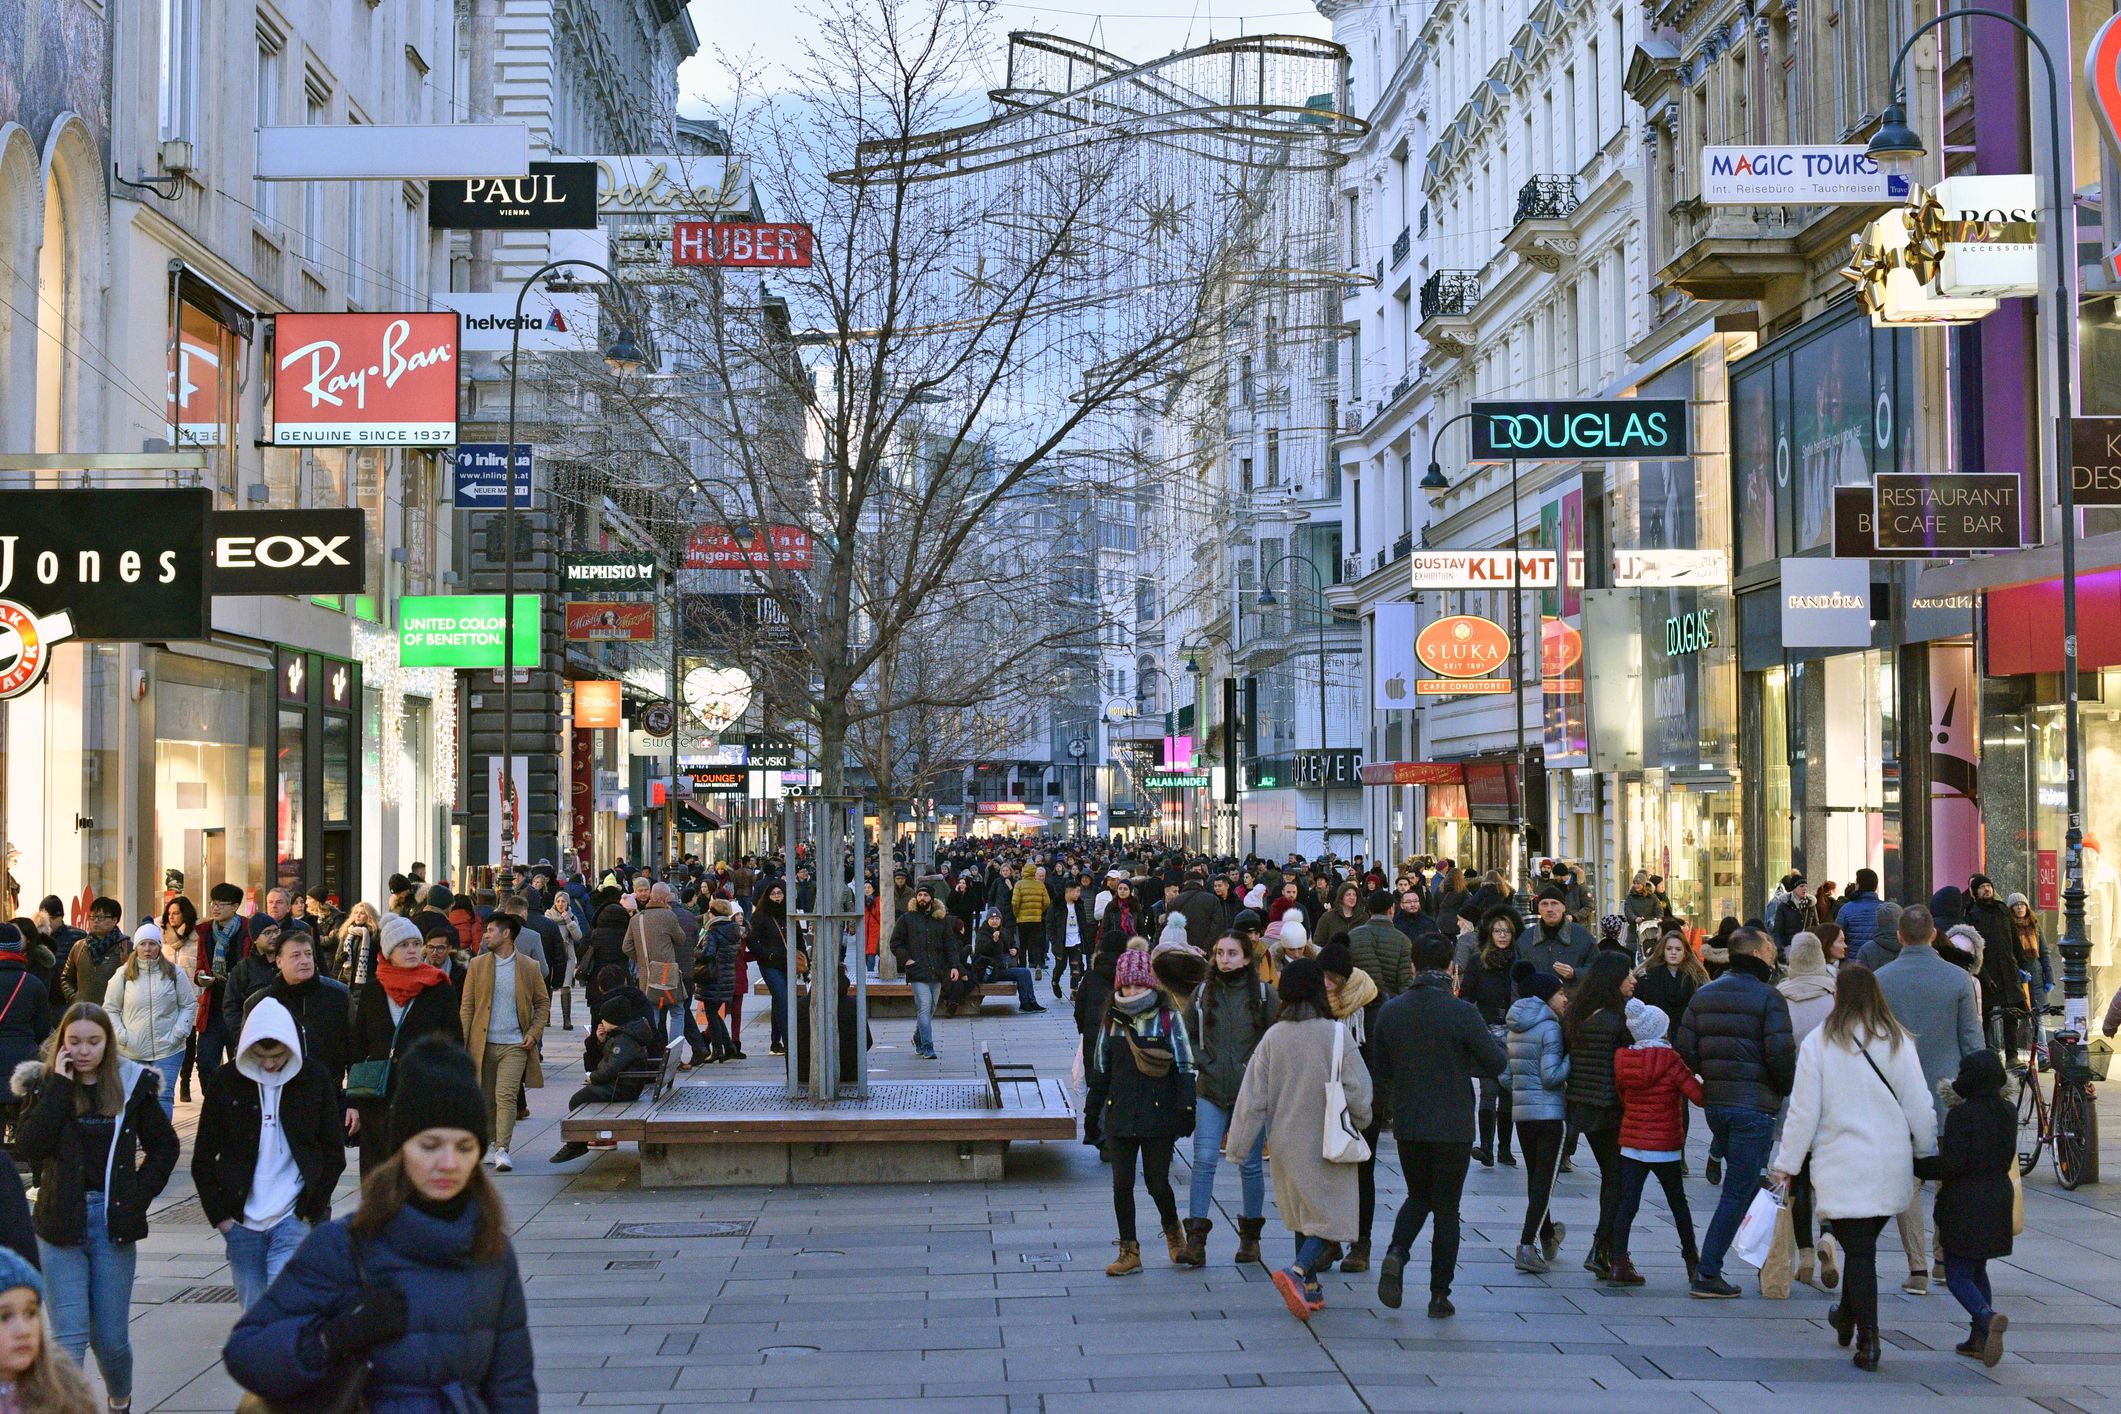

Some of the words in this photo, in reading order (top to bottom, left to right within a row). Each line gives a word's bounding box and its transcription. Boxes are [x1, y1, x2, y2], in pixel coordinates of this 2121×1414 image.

[1711, 153, 1793, 177] MAGIC
[1802, 153, 1879, 178] TOURS
[463, 175, 567, 204] PAUL
[1712, 184, 1730, 194] Int.
[1736, 183, 1794, 194] Reisebüro
[1811, 182, 1881, 193] Tauchreisen
[499, 209, 531, 217] VIENNA
[681, 226, 798, 260] HUBER
[281, 319, 451, 409] Ray-Ban
[280, 430, 352, 442] GENUINE
[359, 430, 407, 441] SINCE
[414, 430, 451, 441] 1937
[1489, 411, 1669, 449] DOUGLAS
[1882, 487, 2015, 507] RESTAURANT
[1894, 515, 1947, 534] CAFE
[1963, 514, 2004, 534] BAR
[211, 535, 351, 568] EOX
[1414, 557, 1466, 570] GUSTAV
[1468, 557, 1555, 580] KLIMT
[567, 565, 636, 580] MEPHISTO
[1414, 571, 1454, 581] EXHIBITION
[1788, 593, 1865, 609] PANDORA
[403, 617, 457, 631] UNITED
[459, 617, 516, 631] COLOR
[403, 633, 424, 646] OF
[426, 633, 504, 646] BENETTON.
[1666, 608, 1710, 657] DOUGLAS
[1426, 643, 1500, 661] SLUKA
[1443, 662, 1462, 670] SEIT
[1466, 662, 1485, 670] 1891
[1449, 682, 1505, 691] CONDITOREI
[642, 736, 702, 750] swach
[1145, 777, 1208, 788] SALAMANDER
[2040, 868, 2056, 885] SALE
